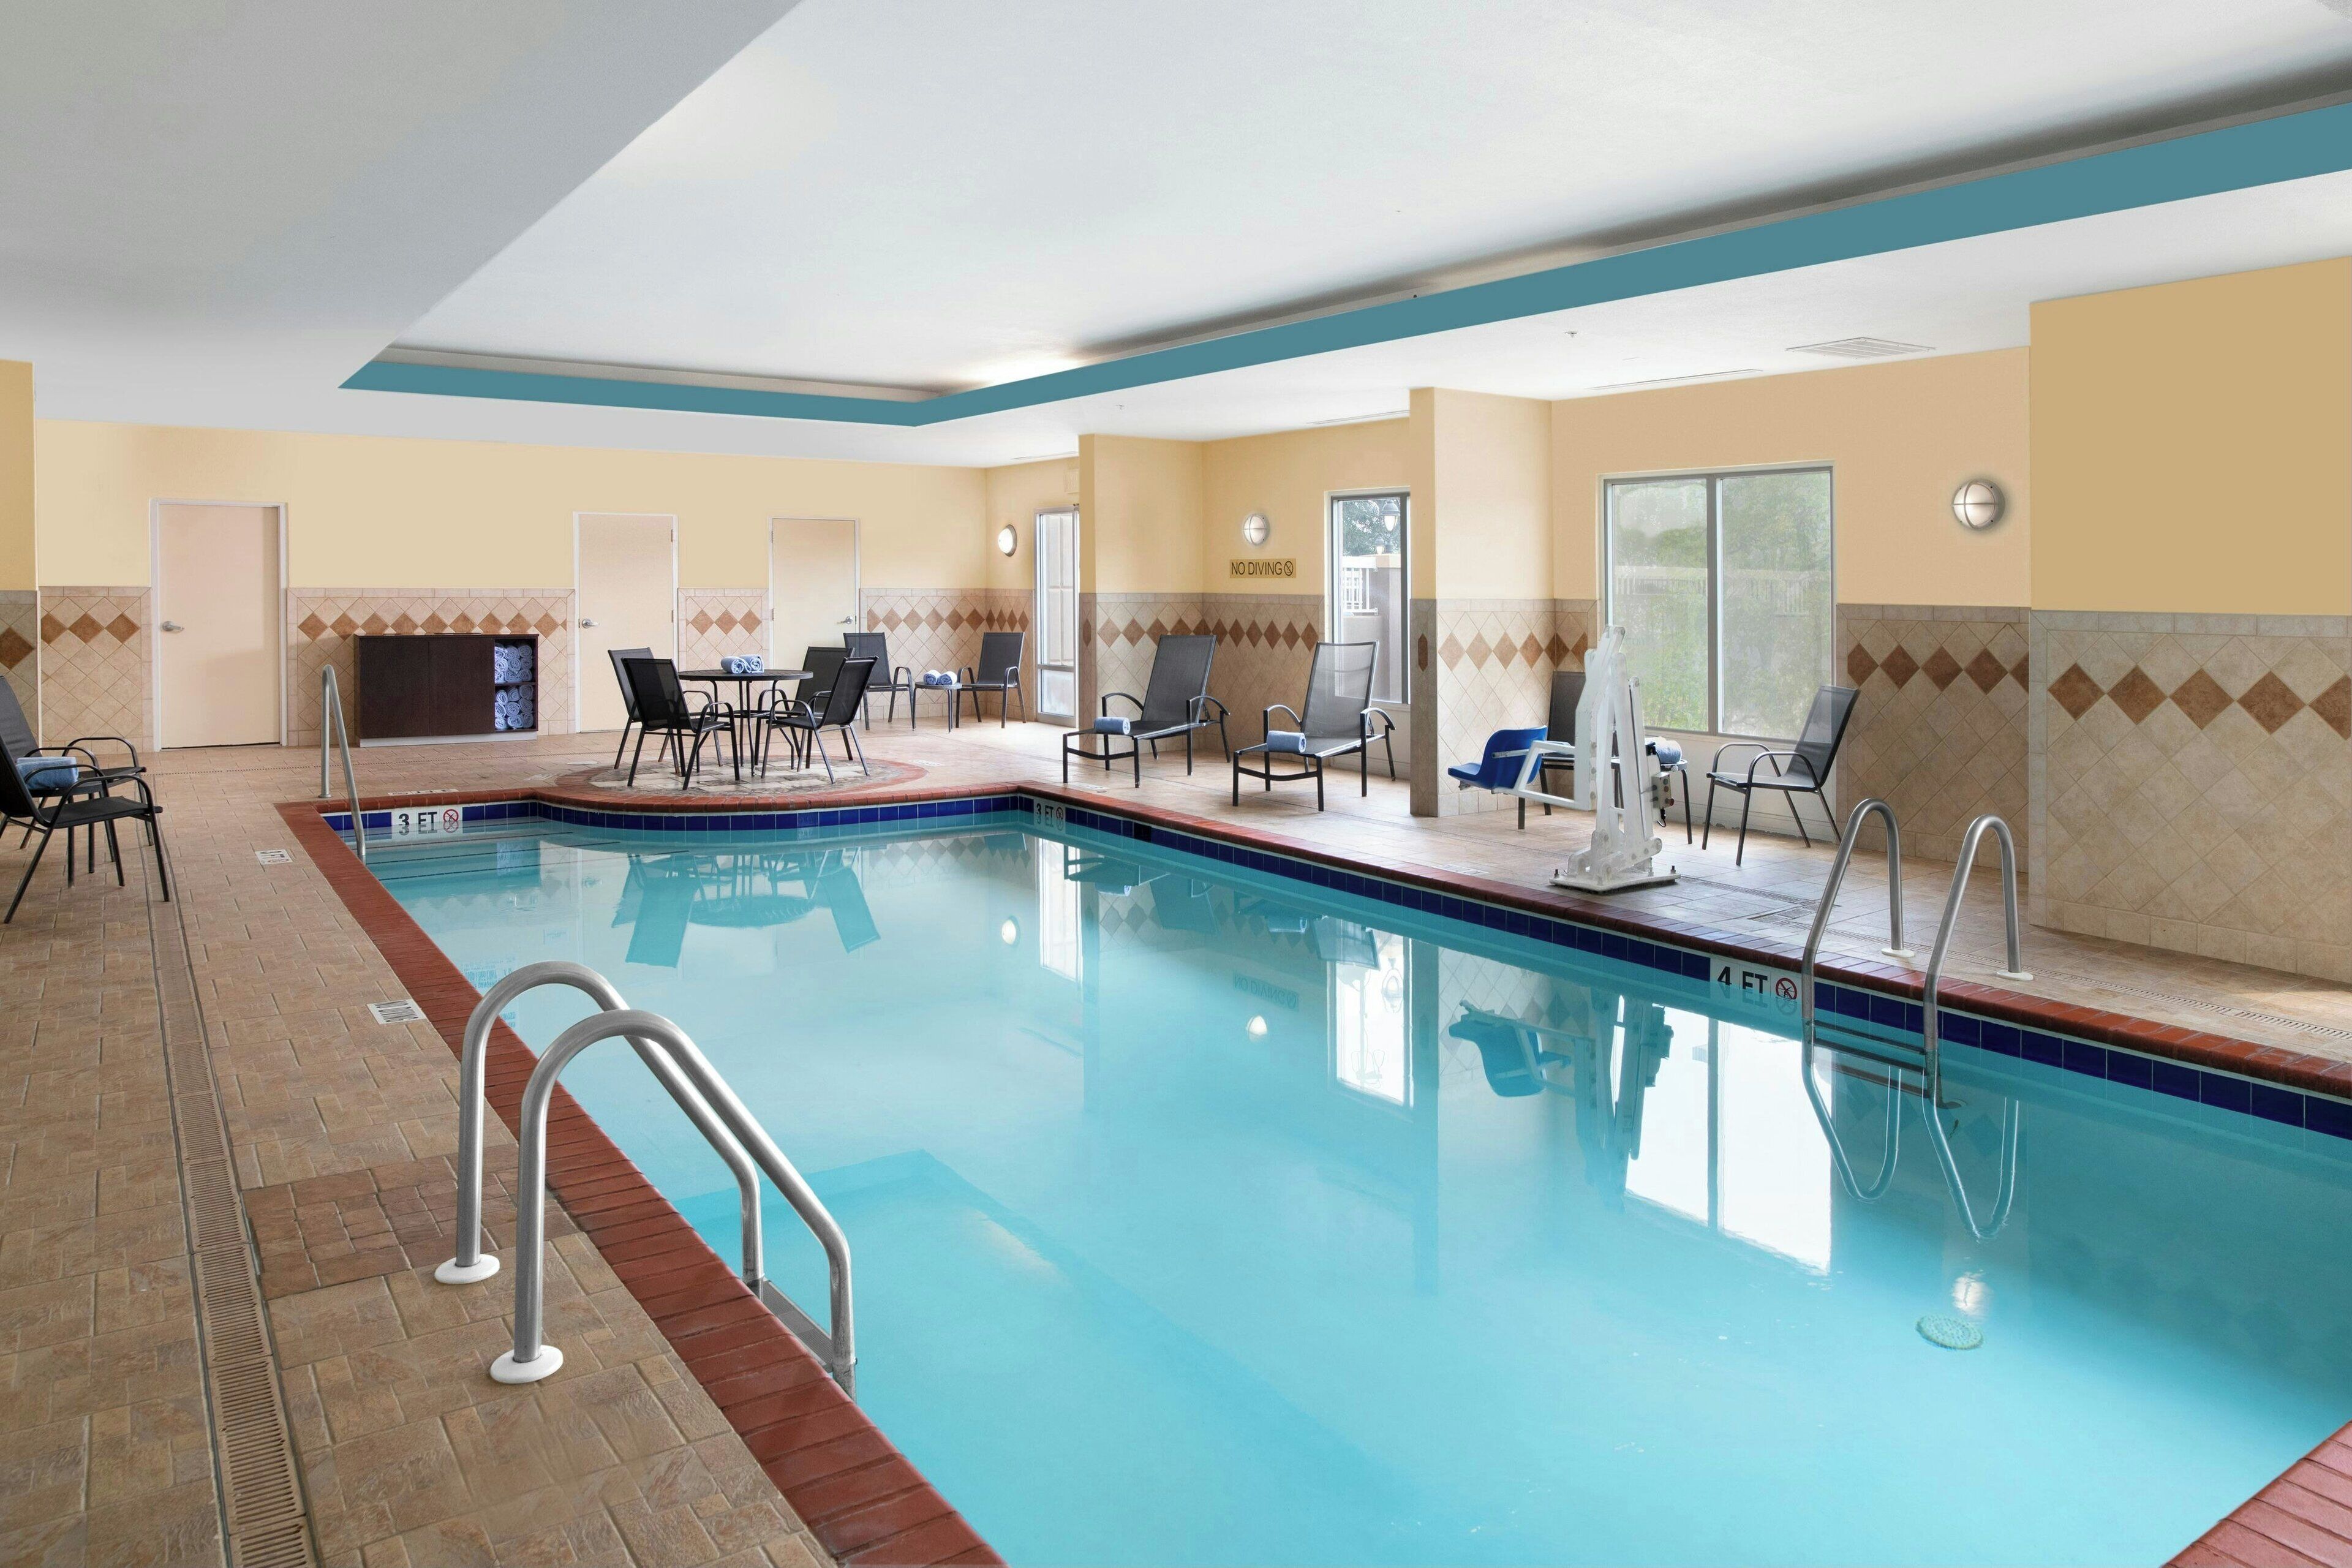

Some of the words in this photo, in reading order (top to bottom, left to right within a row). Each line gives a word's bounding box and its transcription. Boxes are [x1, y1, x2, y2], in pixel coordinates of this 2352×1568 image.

[1231, 562, 1245, 575] NO
[1248, 562, 1283, 575] DIVING
[1036, 803, 1041, 815] 3
[1045, 805, 1054, 818] FT
[398, 813, 410, 826] 3
[418, 812, 437, 825] FT
[1717, 966, 1732, 986] 4
[1743, 971, 1768, 994] FT
